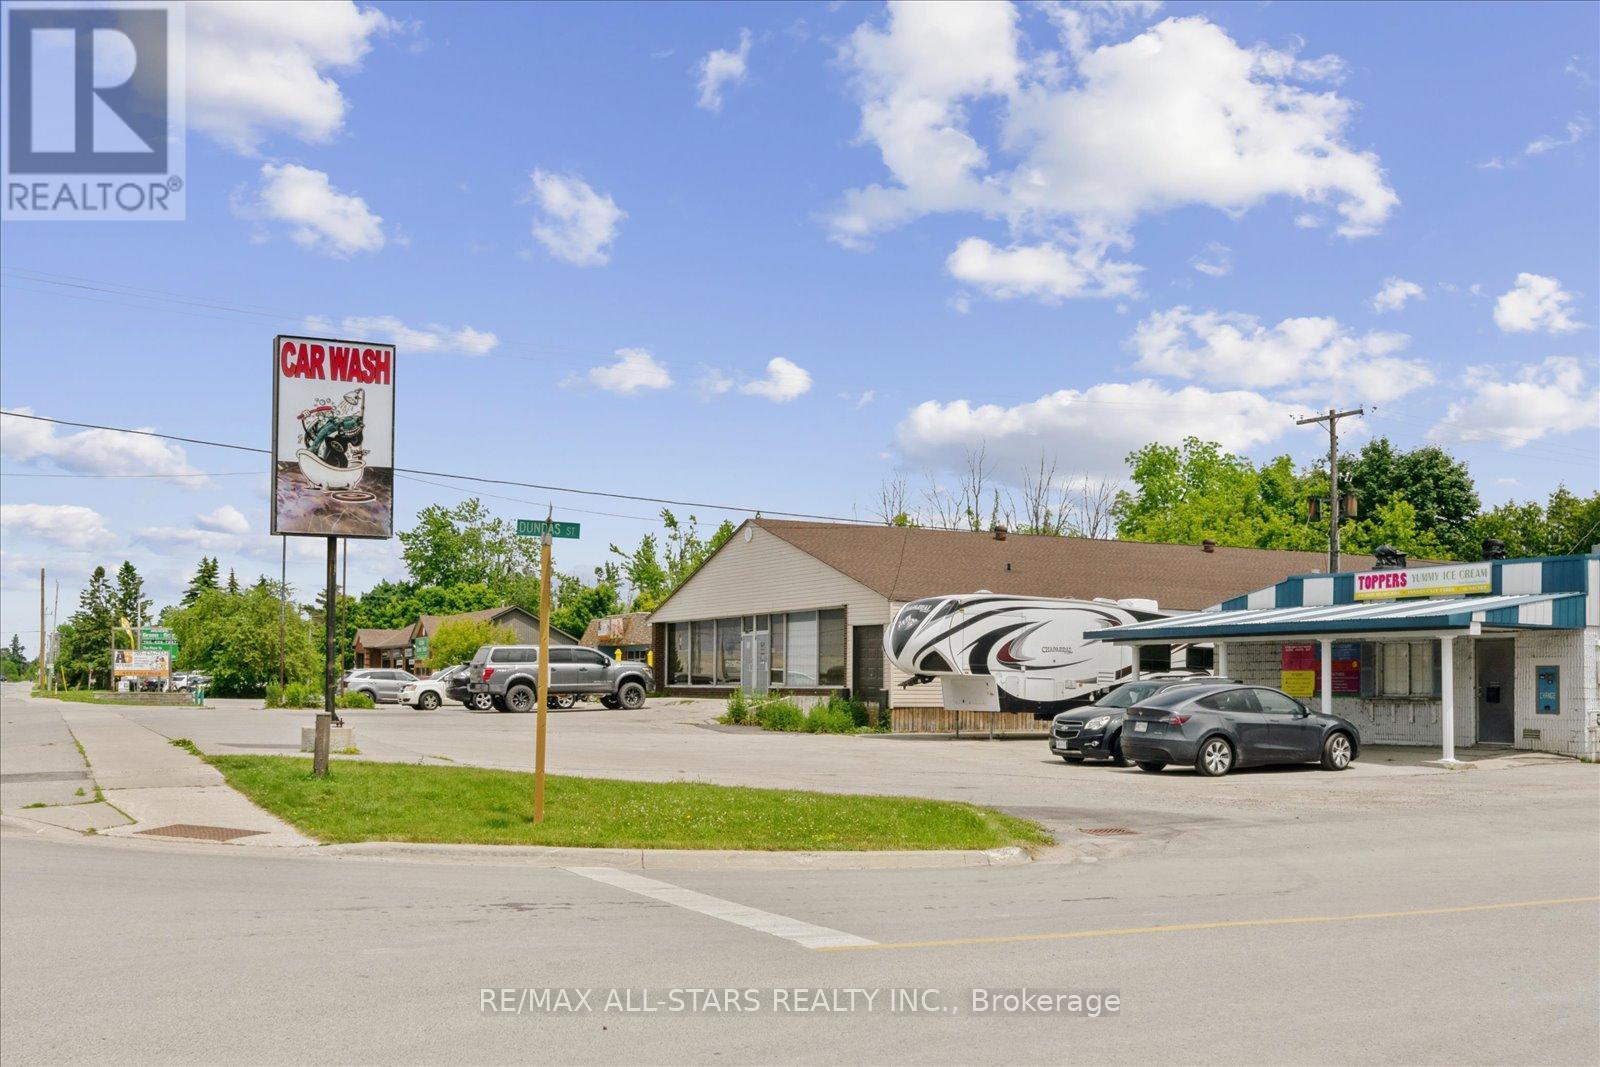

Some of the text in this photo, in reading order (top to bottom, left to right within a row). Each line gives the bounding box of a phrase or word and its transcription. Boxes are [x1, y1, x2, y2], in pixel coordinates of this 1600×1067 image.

[281, 341, 391, 385] CAR WASH
[519, 521, 576, 536] DUNDAS ST
[1358, 568, 1488, 590] TOPPERS YUMMY ICE CREAM
